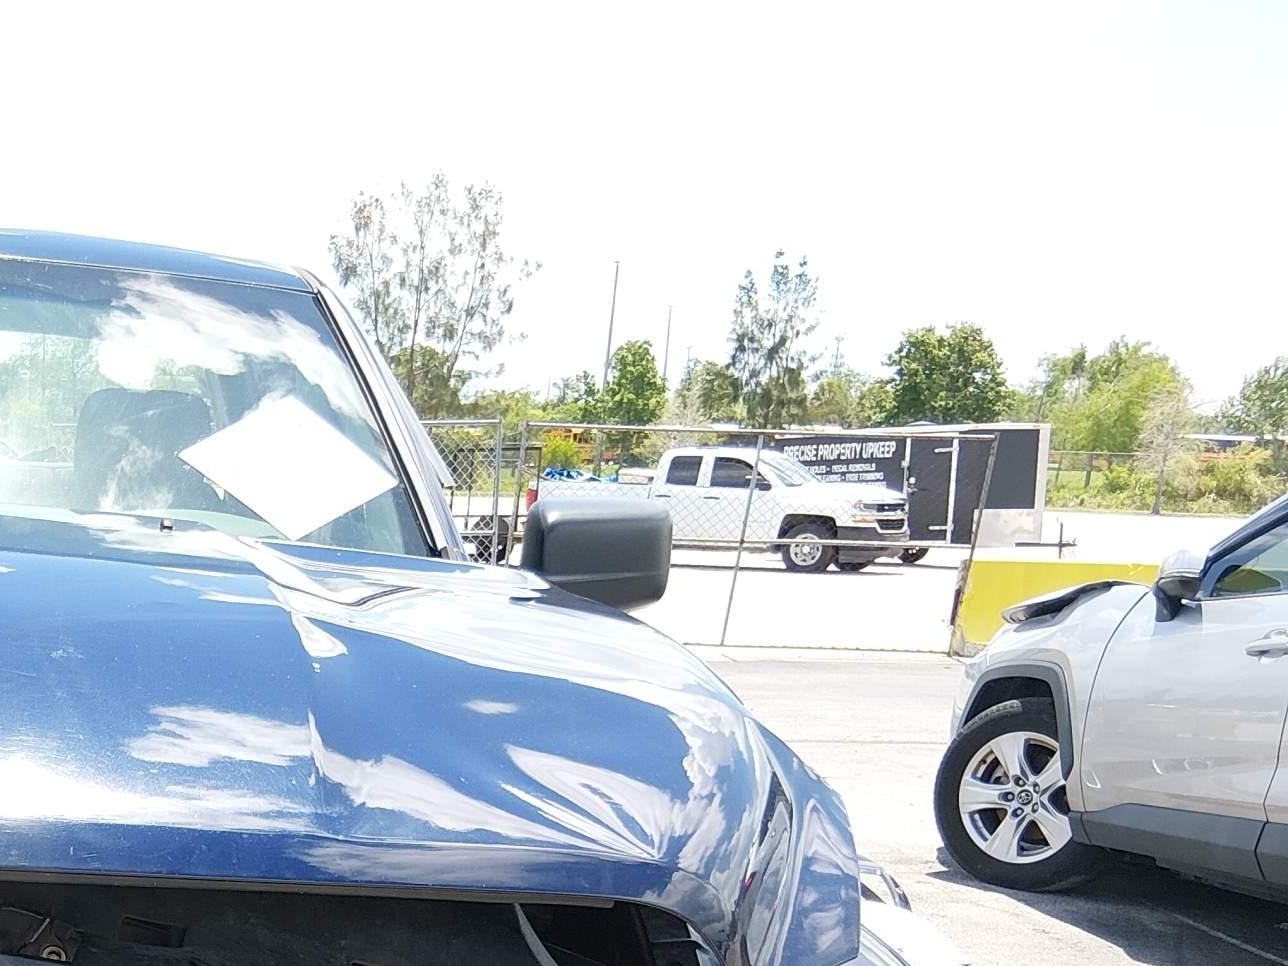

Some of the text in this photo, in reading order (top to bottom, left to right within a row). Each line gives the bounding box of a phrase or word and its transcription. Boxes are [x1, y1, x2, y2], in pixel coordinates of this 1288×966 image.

[783, 441, 896, 462] PRECISE PROPERTY UPKEEP
